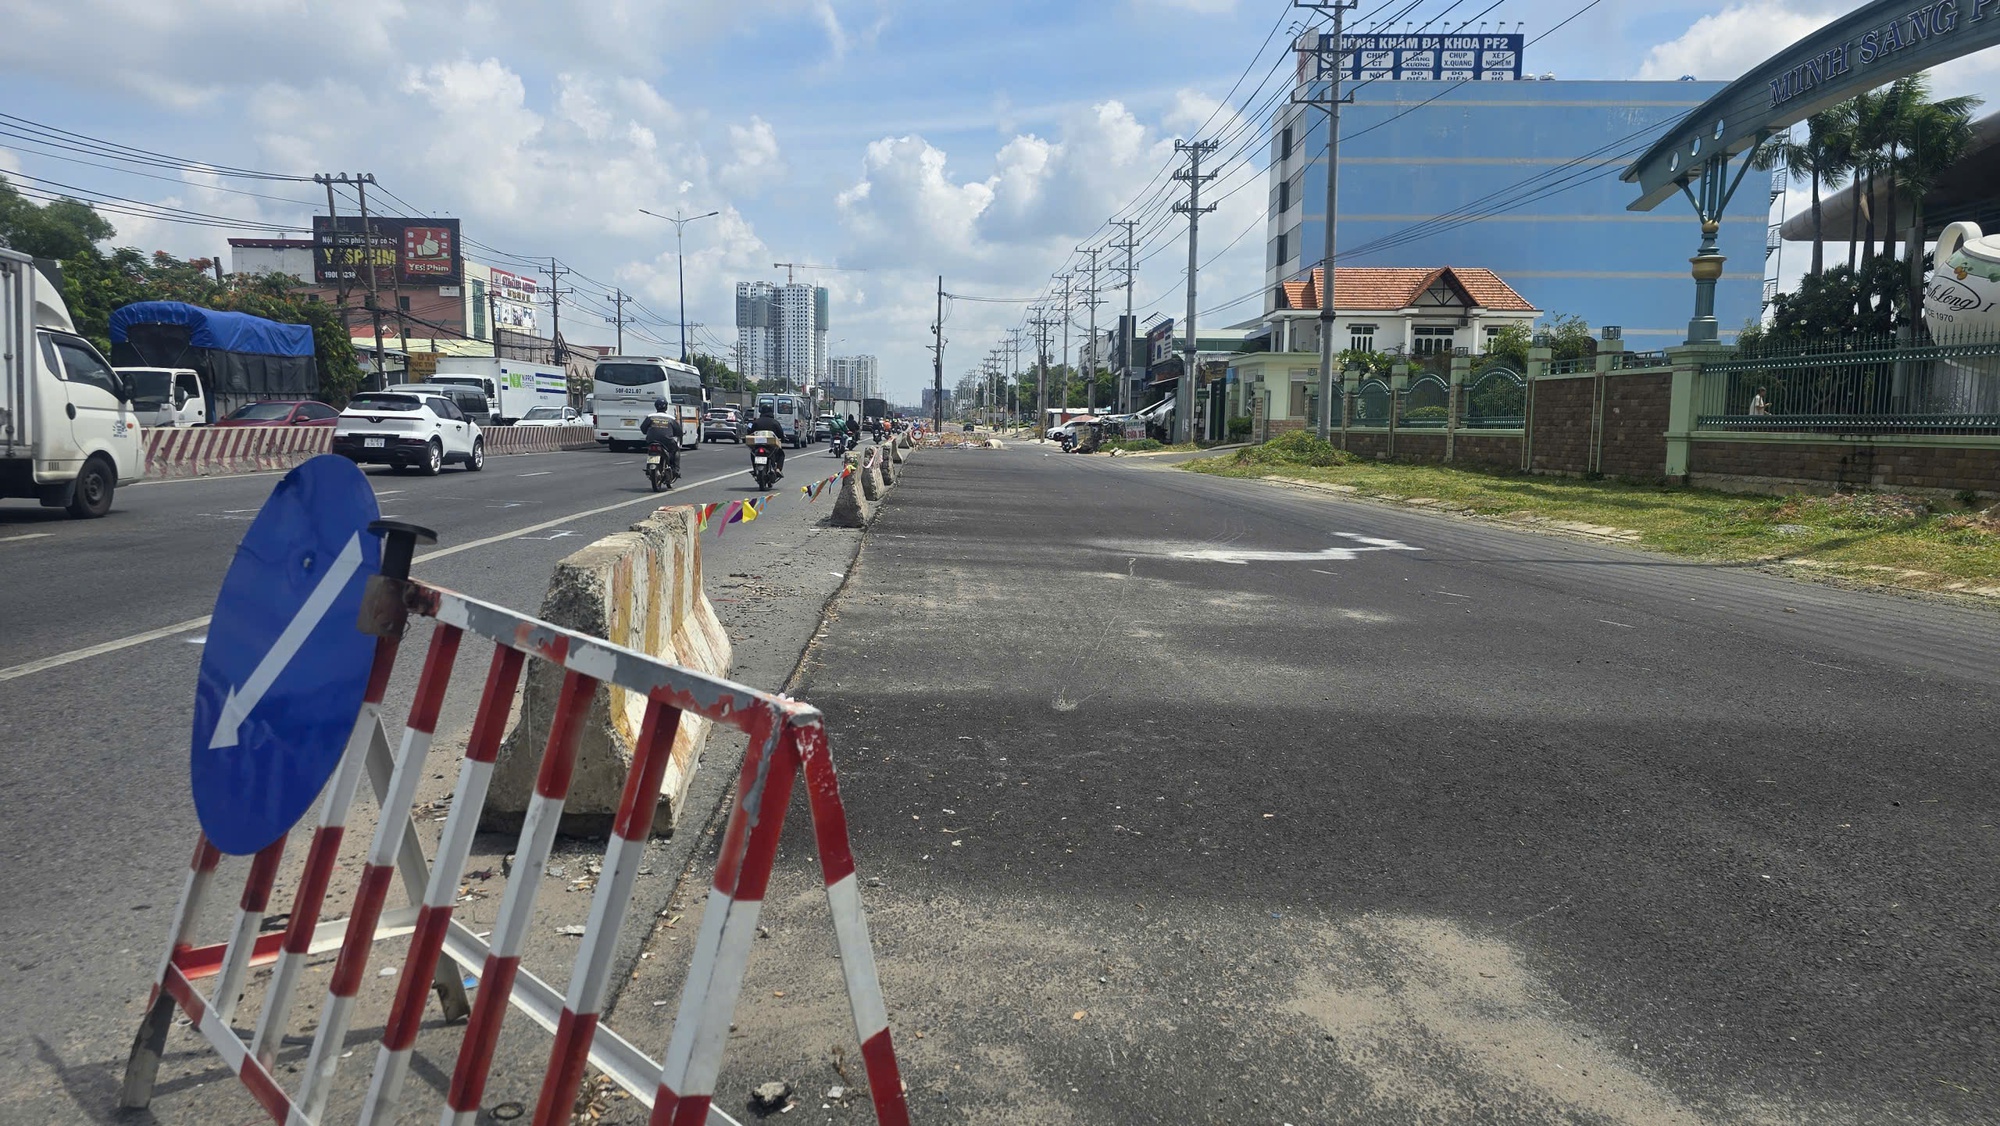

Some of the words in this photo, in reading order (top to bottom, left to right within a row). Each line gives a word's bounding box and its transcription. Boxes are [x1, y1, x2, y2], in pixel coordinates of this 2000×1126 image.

[1379, 35, 1418, 49] KHÁM
[1422, 38, 1440, 49] ĐA
[1444, 38, 1480, 49] KHOA
[1484, 38, 1508, 49] PF2
[1769, 42, 1850, 108] MINH
[1859, 0, 1958, 64] SANG
[1936, 312, 1953, 323] 1970
